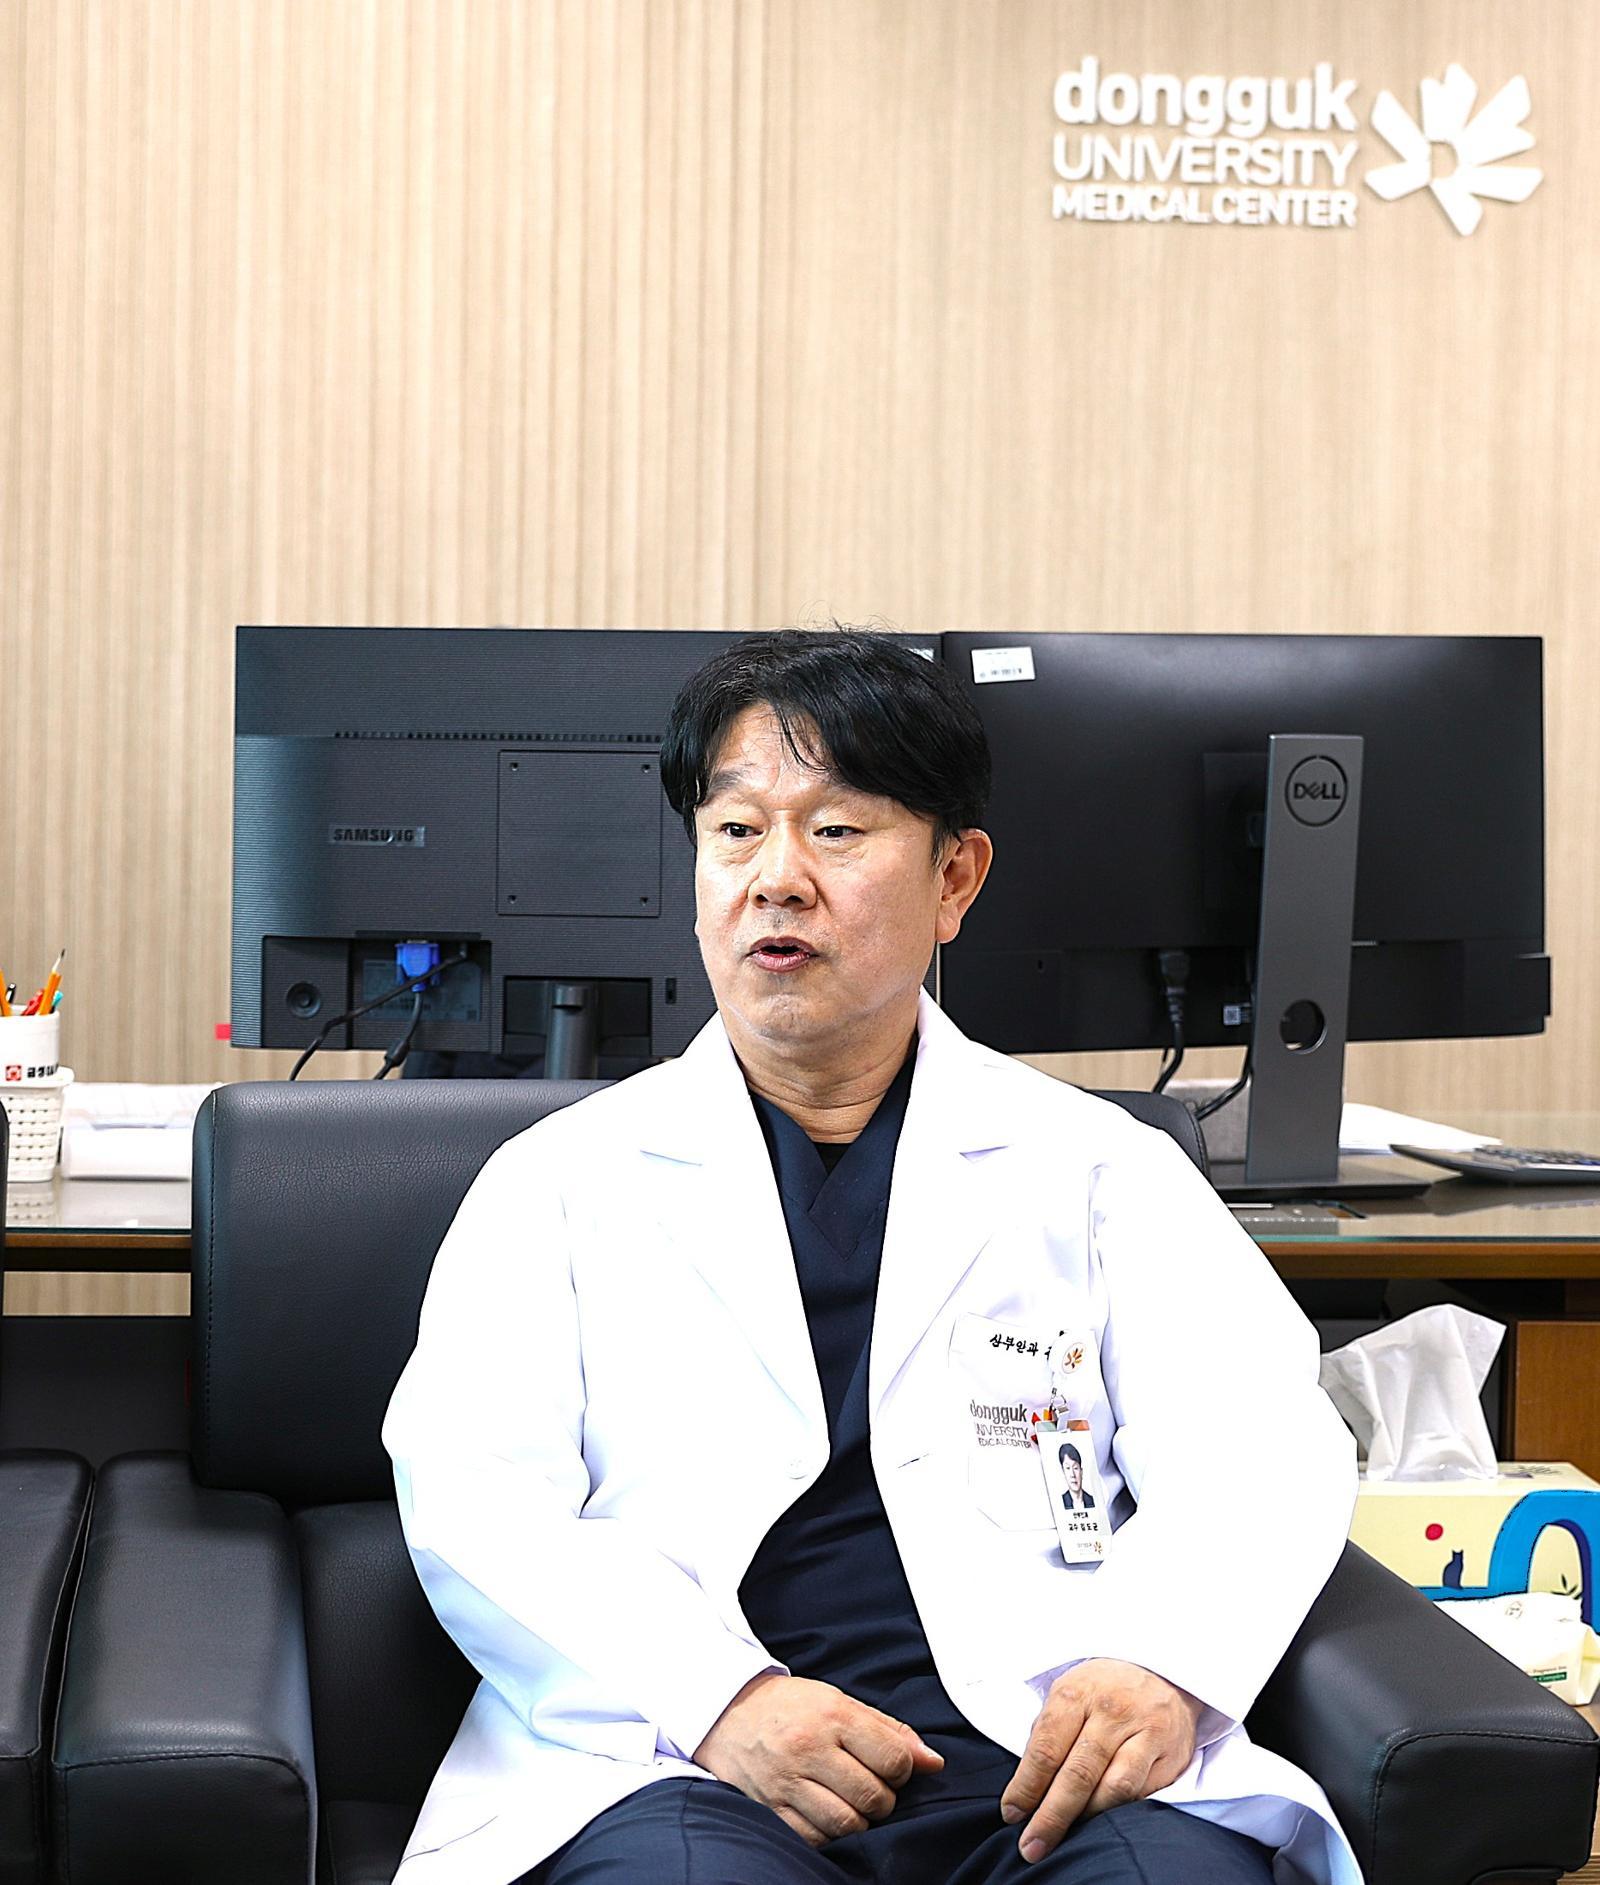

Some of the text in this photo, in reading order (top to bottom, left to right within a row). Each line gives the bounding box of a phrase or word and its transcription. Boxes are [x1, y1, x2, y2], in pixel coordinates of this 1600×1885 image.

[1053, 56, 1358, 138] dongguk
[1053, 133, 1358, 186] UNIVERSITY
[1052, 184, 1357, 227] MEDICAL CENTER
[1294, 781, 1340, 800] DELL
[334, 828, 414, 842] SAMSUNG
[970, 1399, 1027, 1425] dongguk
[976, 1422, 1028, 1440] NIVERSITY
[978, 1437, 1006, 1447] EDICAL
